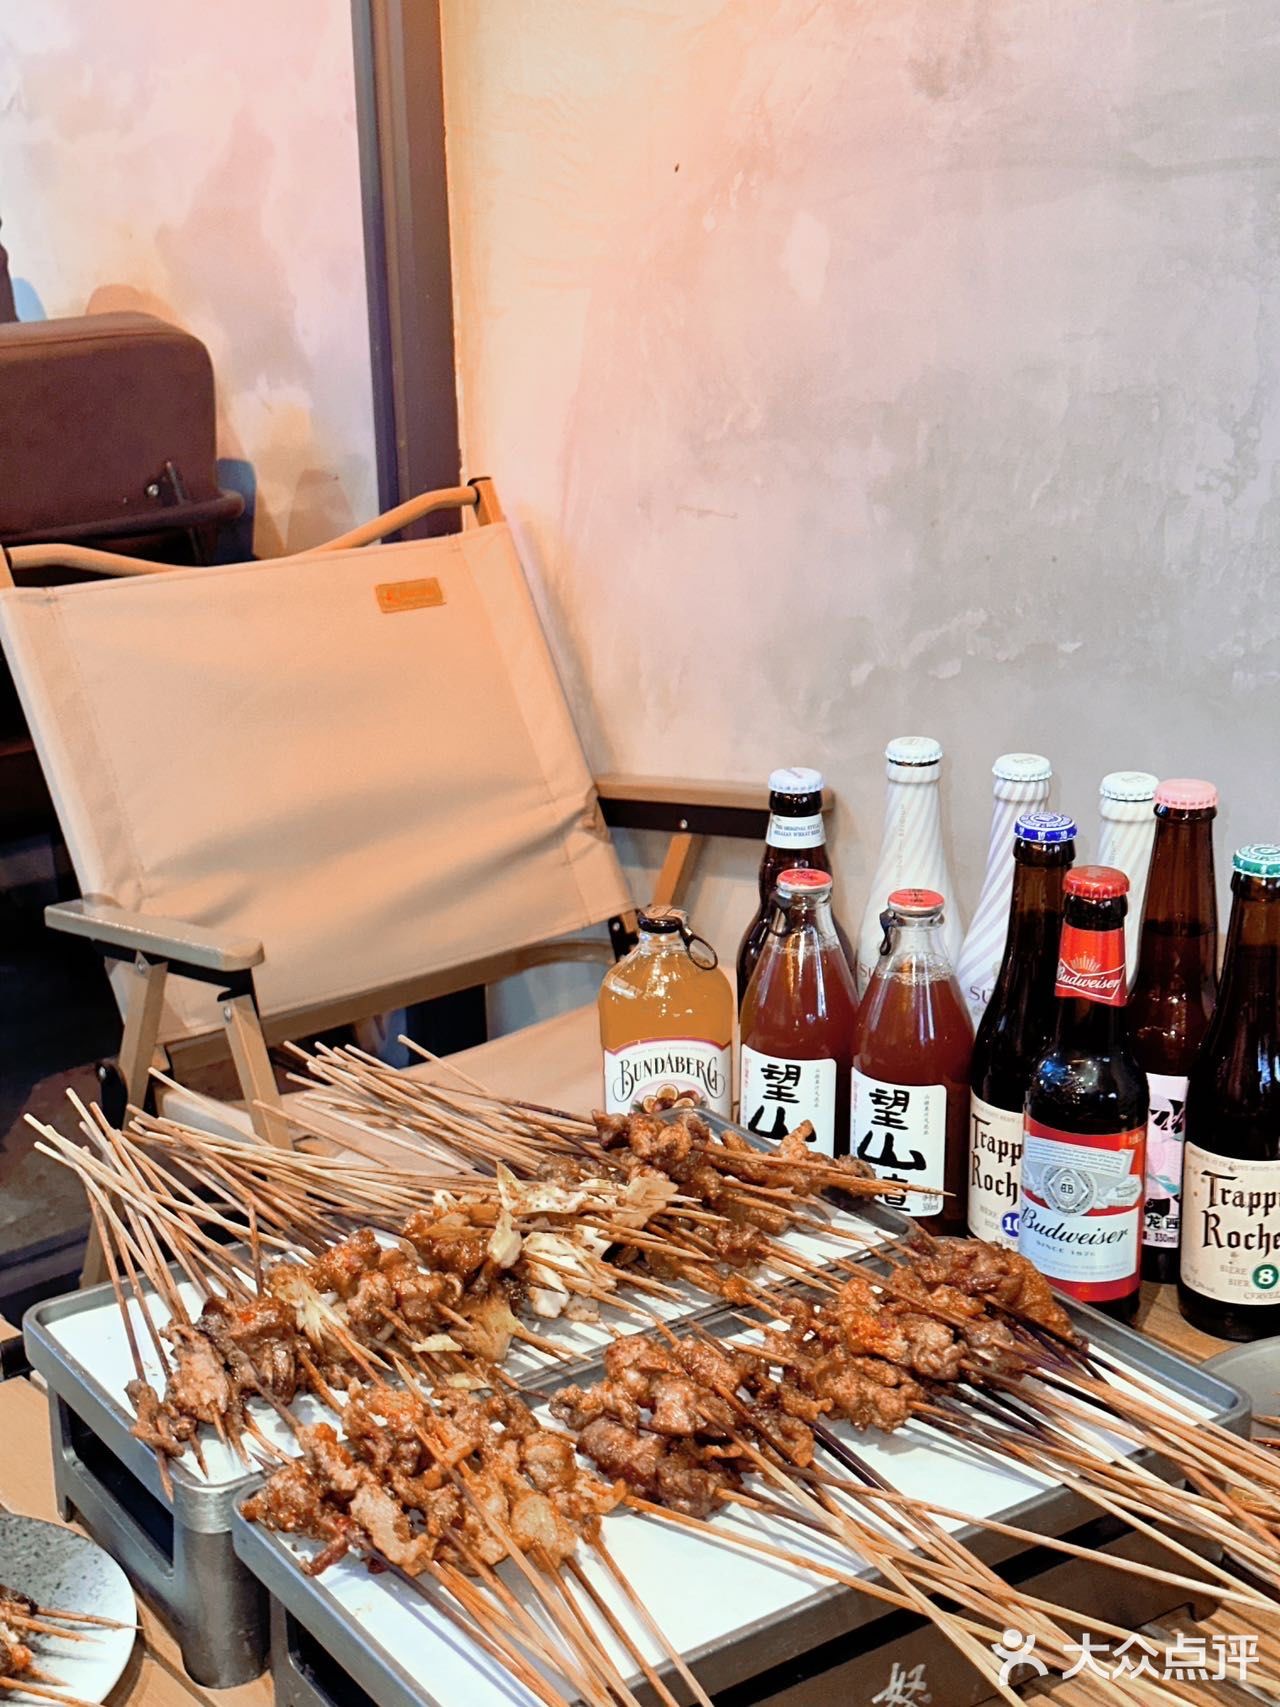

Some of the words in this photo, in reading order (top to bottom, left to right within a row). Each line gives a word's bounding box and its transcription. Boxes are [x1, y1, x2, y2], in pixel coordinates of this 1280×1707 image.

[1057, 965, 1121, 989] Budweiser
[613, 1052, 726, 1103] BUNDABERG
[971, 1151, 1018, 1206] Roch
[1201, 1169, 1280, 1217] Trapp
[1021, 1206, 1129, 1246] Budweiser
[1257, 1268, 1275, 1285] 8
